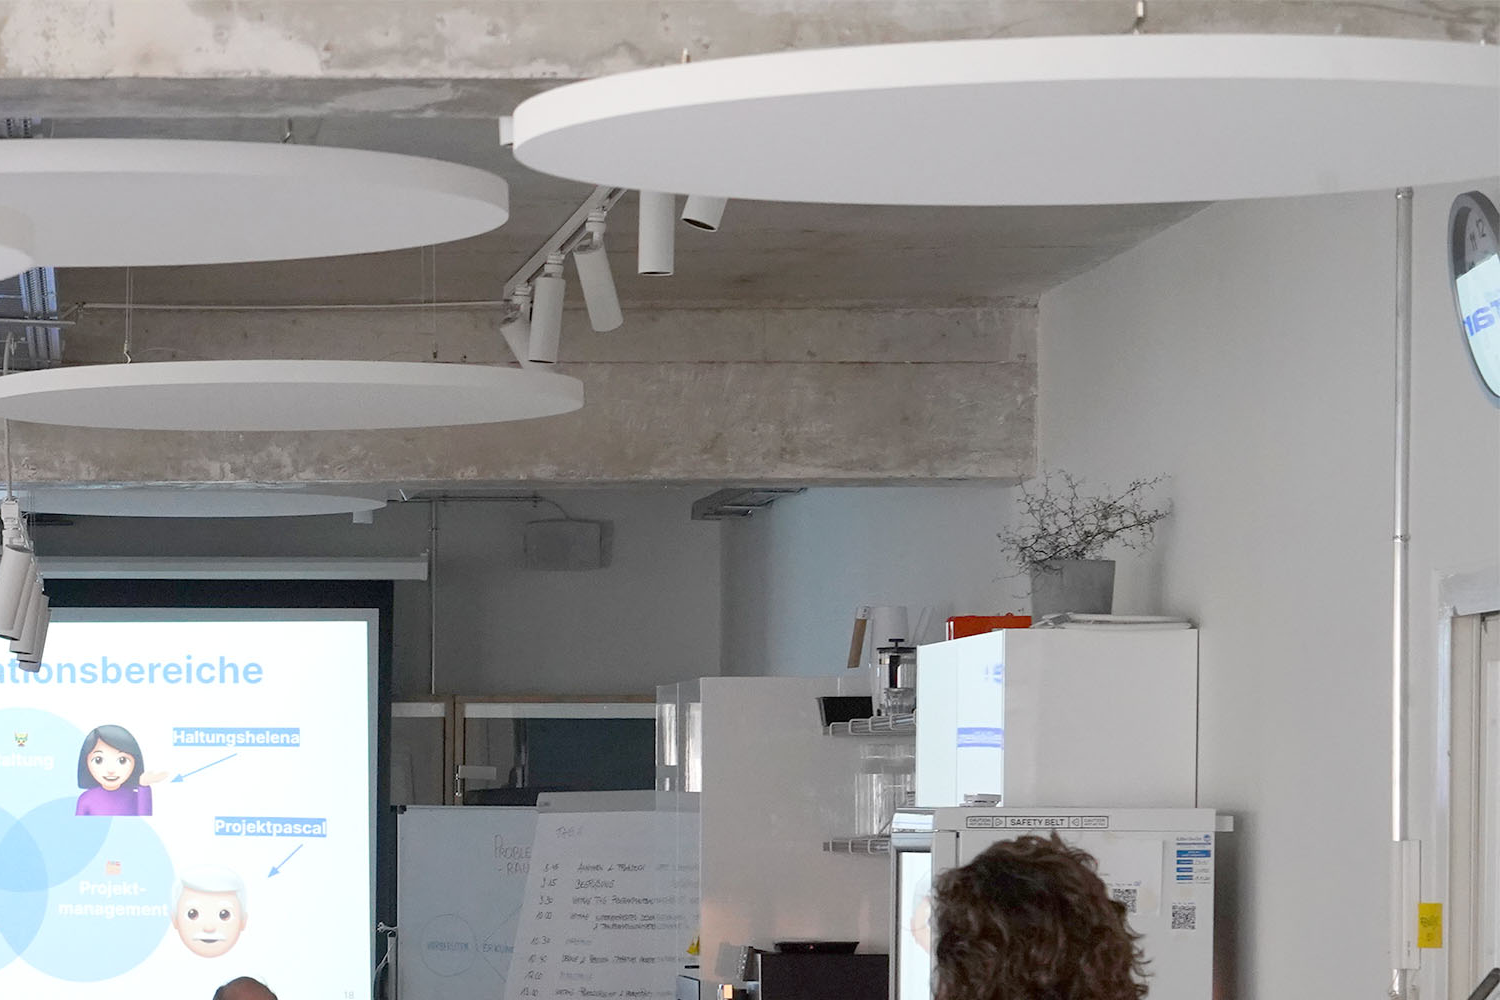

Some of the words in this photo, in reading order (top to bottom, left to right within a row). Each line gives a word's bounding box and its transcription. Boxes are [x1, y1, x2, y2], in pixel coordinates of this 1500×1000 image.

[172, 730, 300, 747] Haltungshelena
[214, 819, 327, 837] Projektpascal
[1010, 818, 1044, 826] SAFETY
[1044, 818, 1065, 826] BELT
[78, 881, 147, 898] Projekt-
[58, 902, 169, 920] management
[343, 990, 355, 1000] 18
